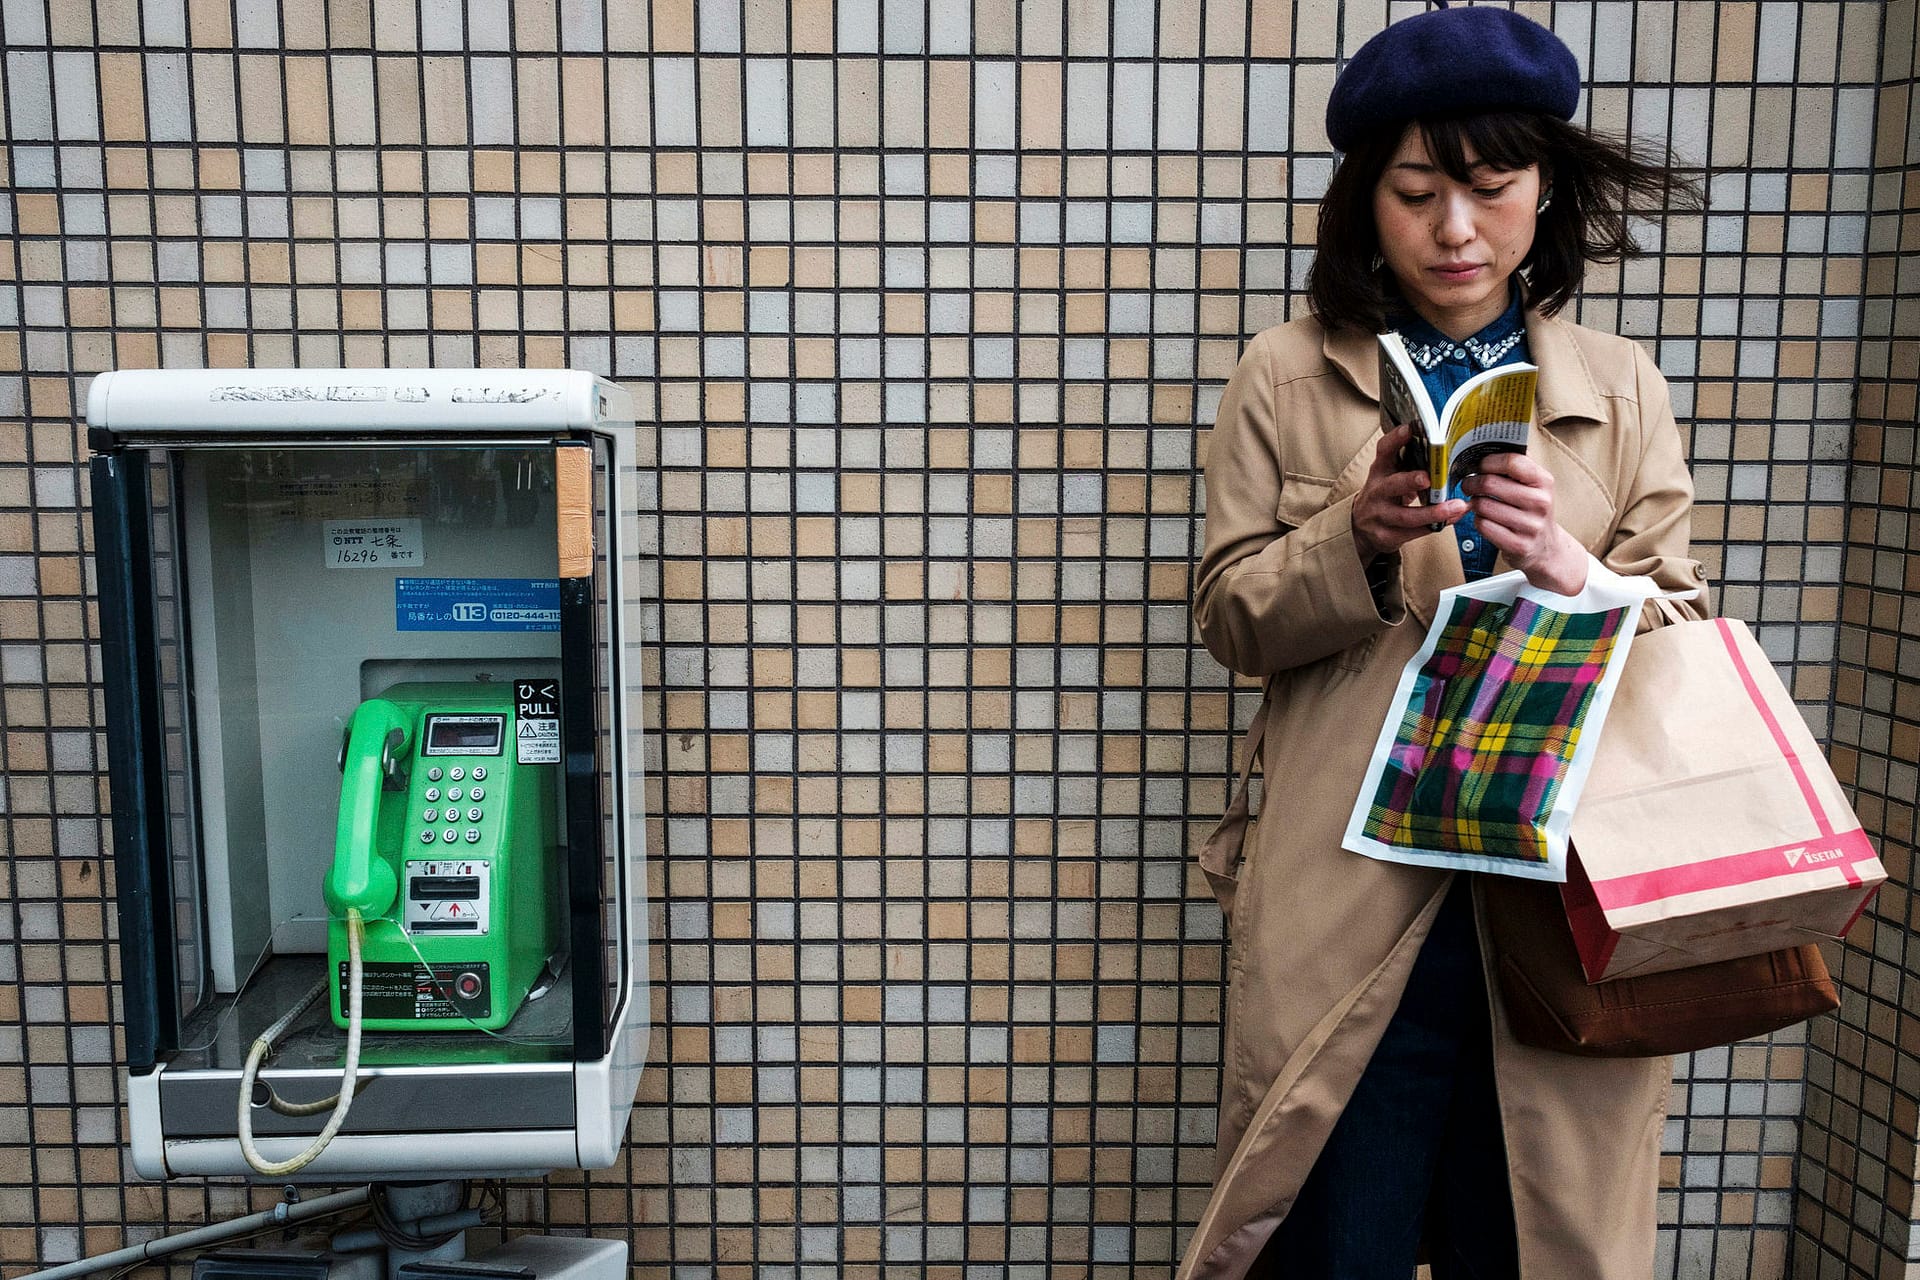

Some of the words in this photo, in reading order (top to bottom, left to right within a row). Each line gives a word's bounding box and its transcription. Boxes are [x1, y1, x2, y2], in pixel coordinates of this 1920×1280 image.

[337, 549, 378, 563] 16296
[391, 551, 414, 559] 番です
[454, 604, 485, 620] 113
[519, 684, 555, 700] ひく
[519, 703, 555, 715] PULL
[538, 722, 557, 731] 注意
